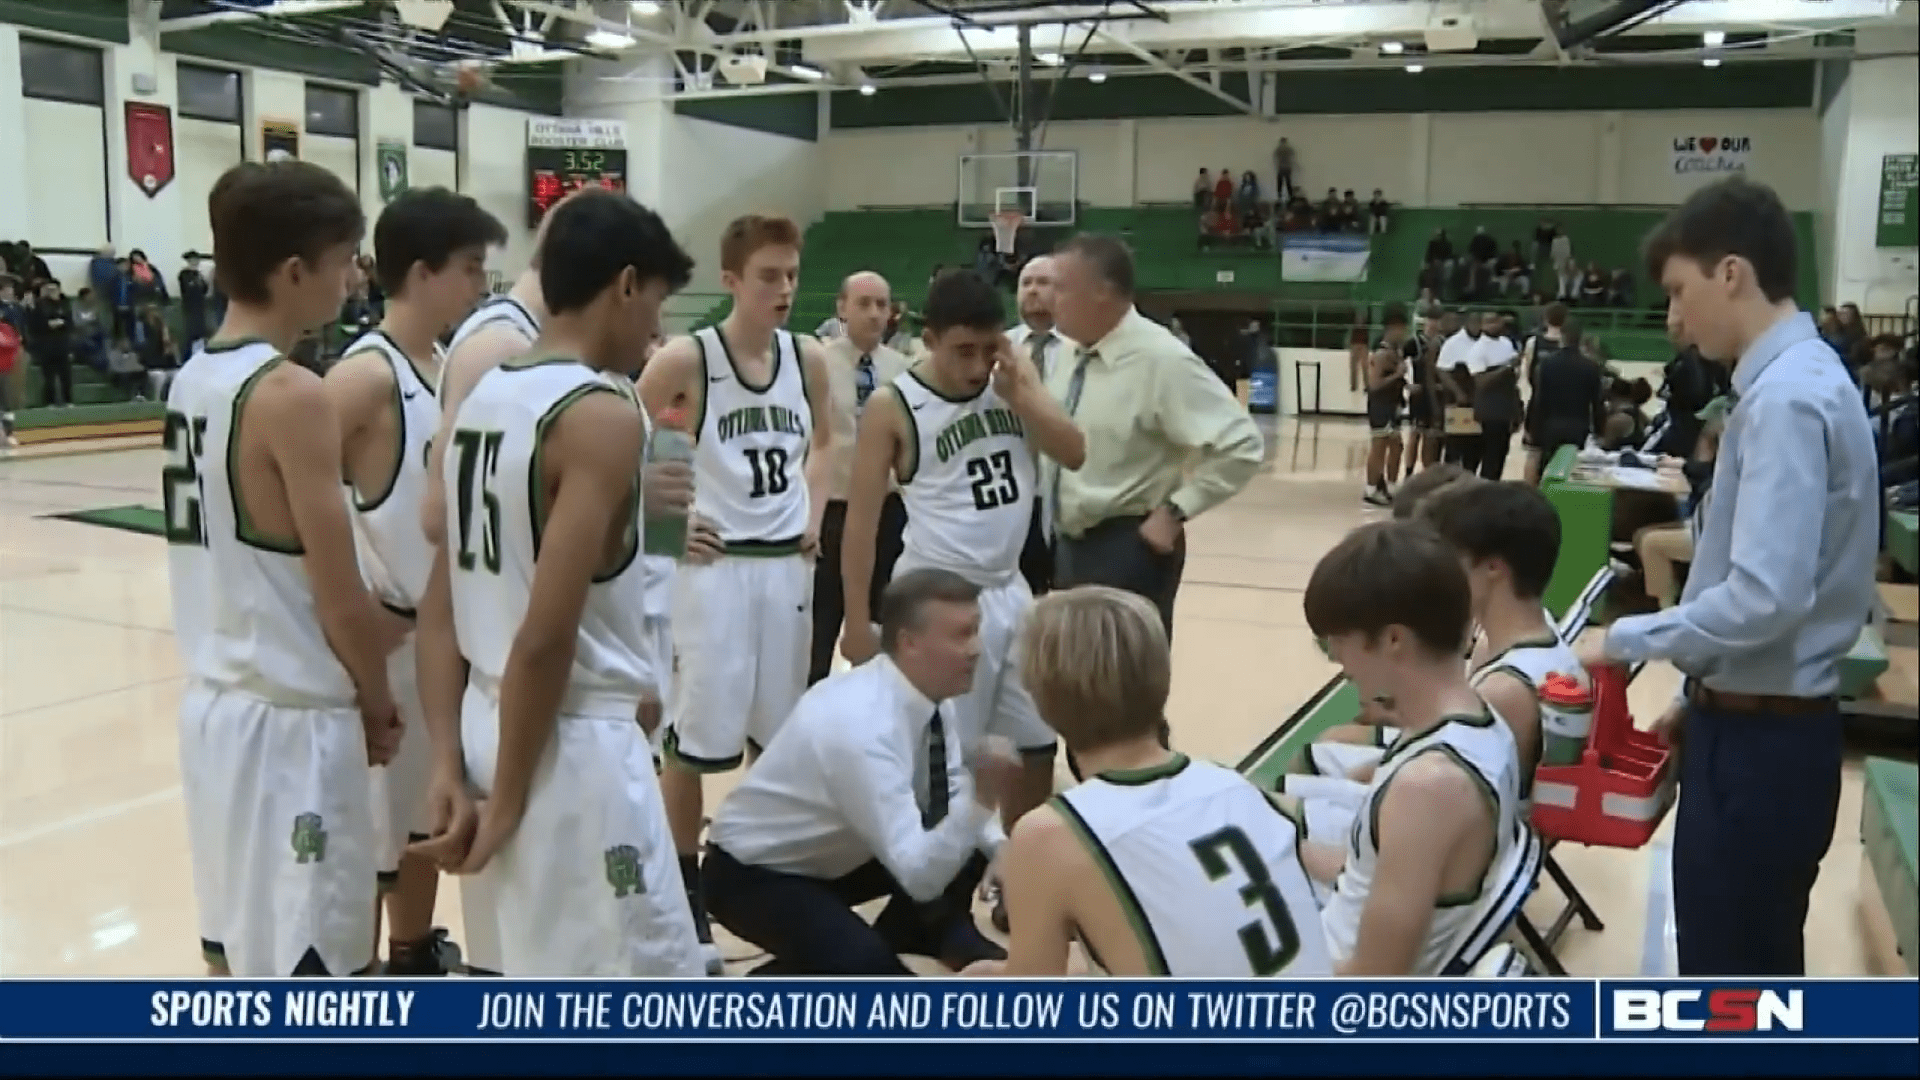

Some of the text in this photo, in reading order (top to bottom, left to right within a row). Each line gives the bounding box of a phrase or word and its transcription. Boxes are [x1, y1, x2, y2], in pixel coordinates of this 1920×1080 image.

[1674, 137, 1750, 152] WE OUR
[967, 450, 1019, 511] 23
[1188, 823, 1300, 977] 3
